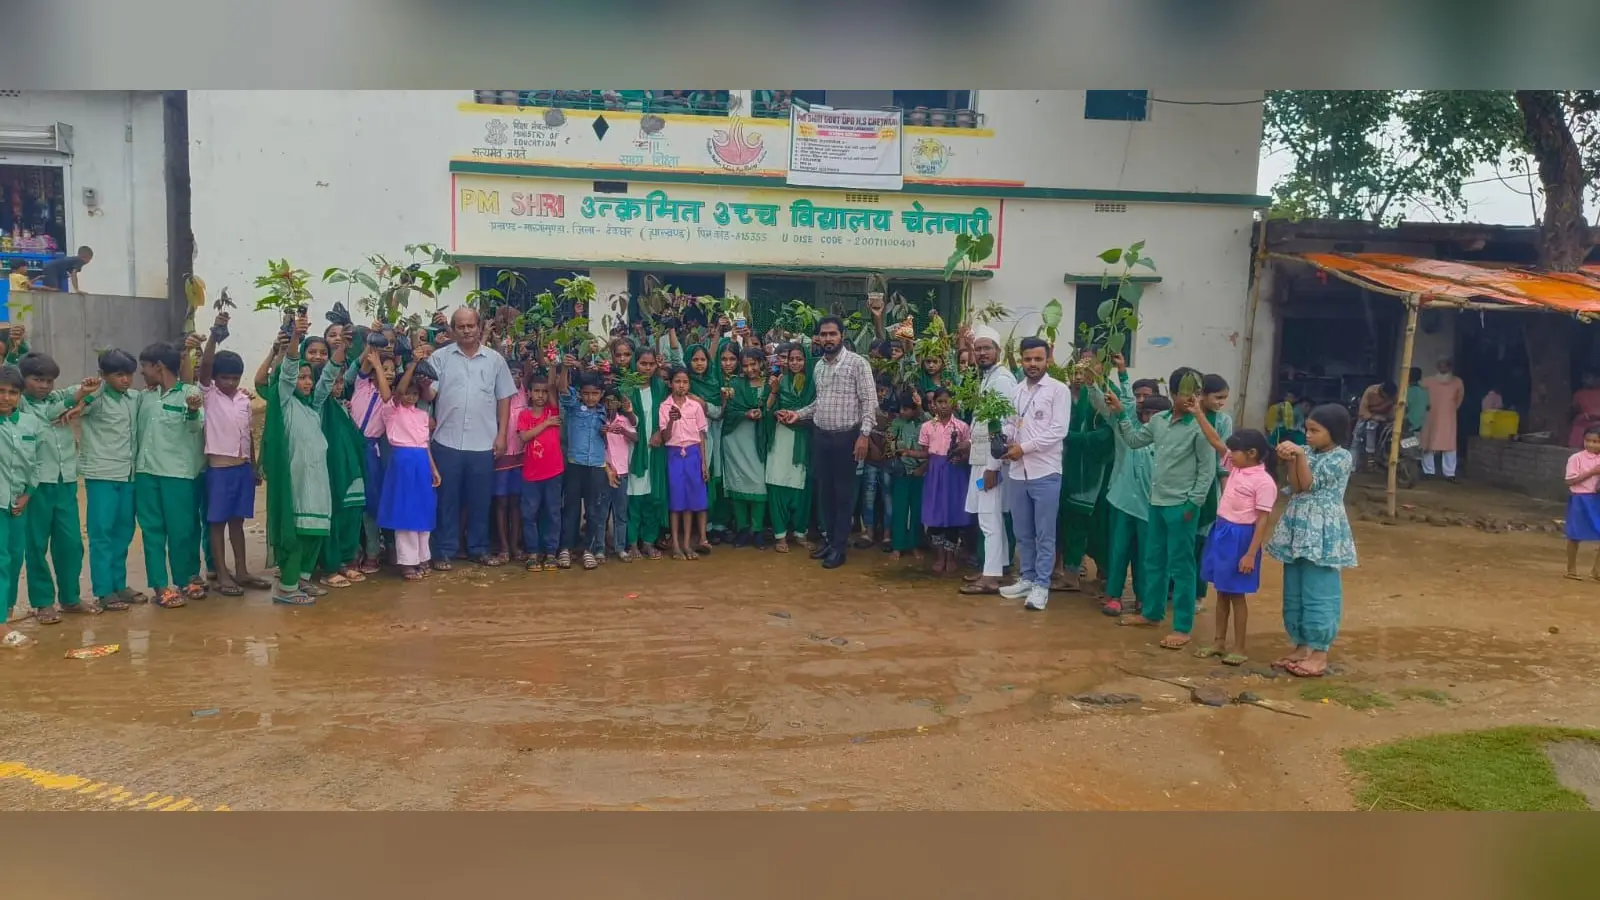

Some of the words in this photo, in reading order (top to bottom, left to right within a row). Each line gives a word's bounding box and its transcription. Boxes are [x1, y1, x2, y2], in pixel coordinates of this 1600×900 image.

[513, 131, 545, 139] MINISTRY
[549, 132, 560, 140] OF
[513, 139, 557, 148] EDUCATION
[460, 188, 500, 215] PM
[510, 191, 565, 218] SHRI
[790, 199, 893, 233] विद्यालय
[793, 234, 812, 244] DISE
[820, 235, 843, 244] CODE
